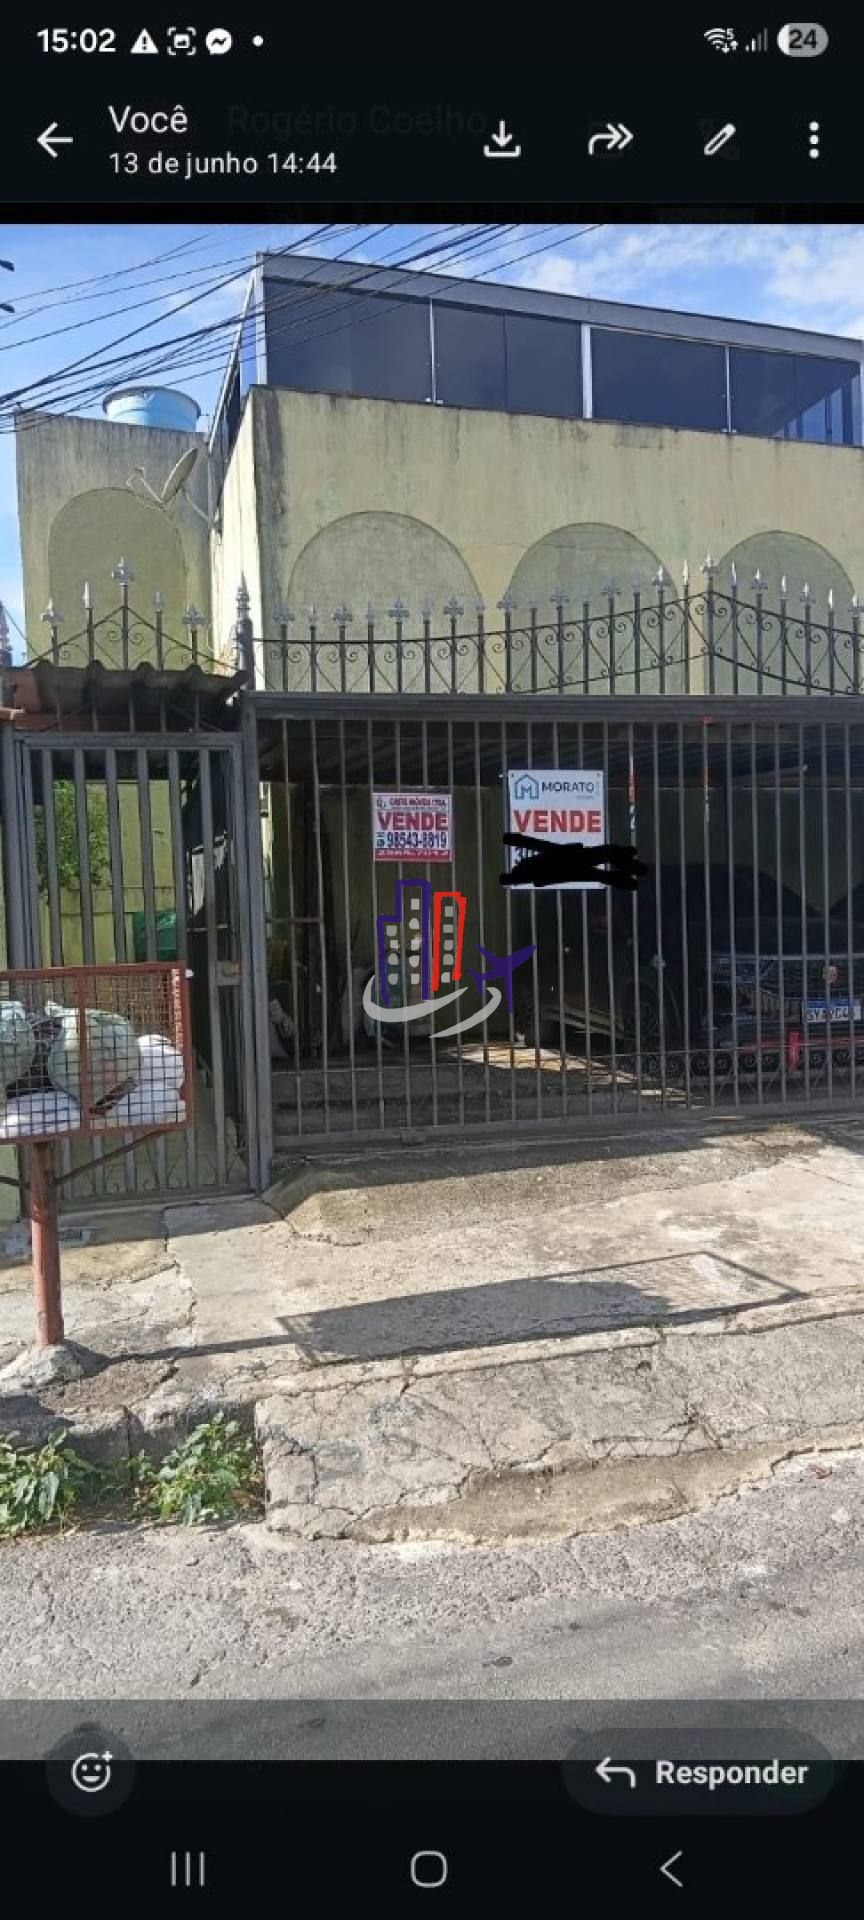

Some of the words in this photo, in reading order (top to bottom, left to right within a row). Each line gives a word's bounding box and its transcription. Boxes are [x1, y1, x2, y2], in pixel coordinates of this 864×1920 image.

[541, 781, 595, 793] MORATO
[377, 812, 448, 831] VENDE
[513, 810, 602, 833] VENDE
[387, 831, 447, 848] 98543-8819
